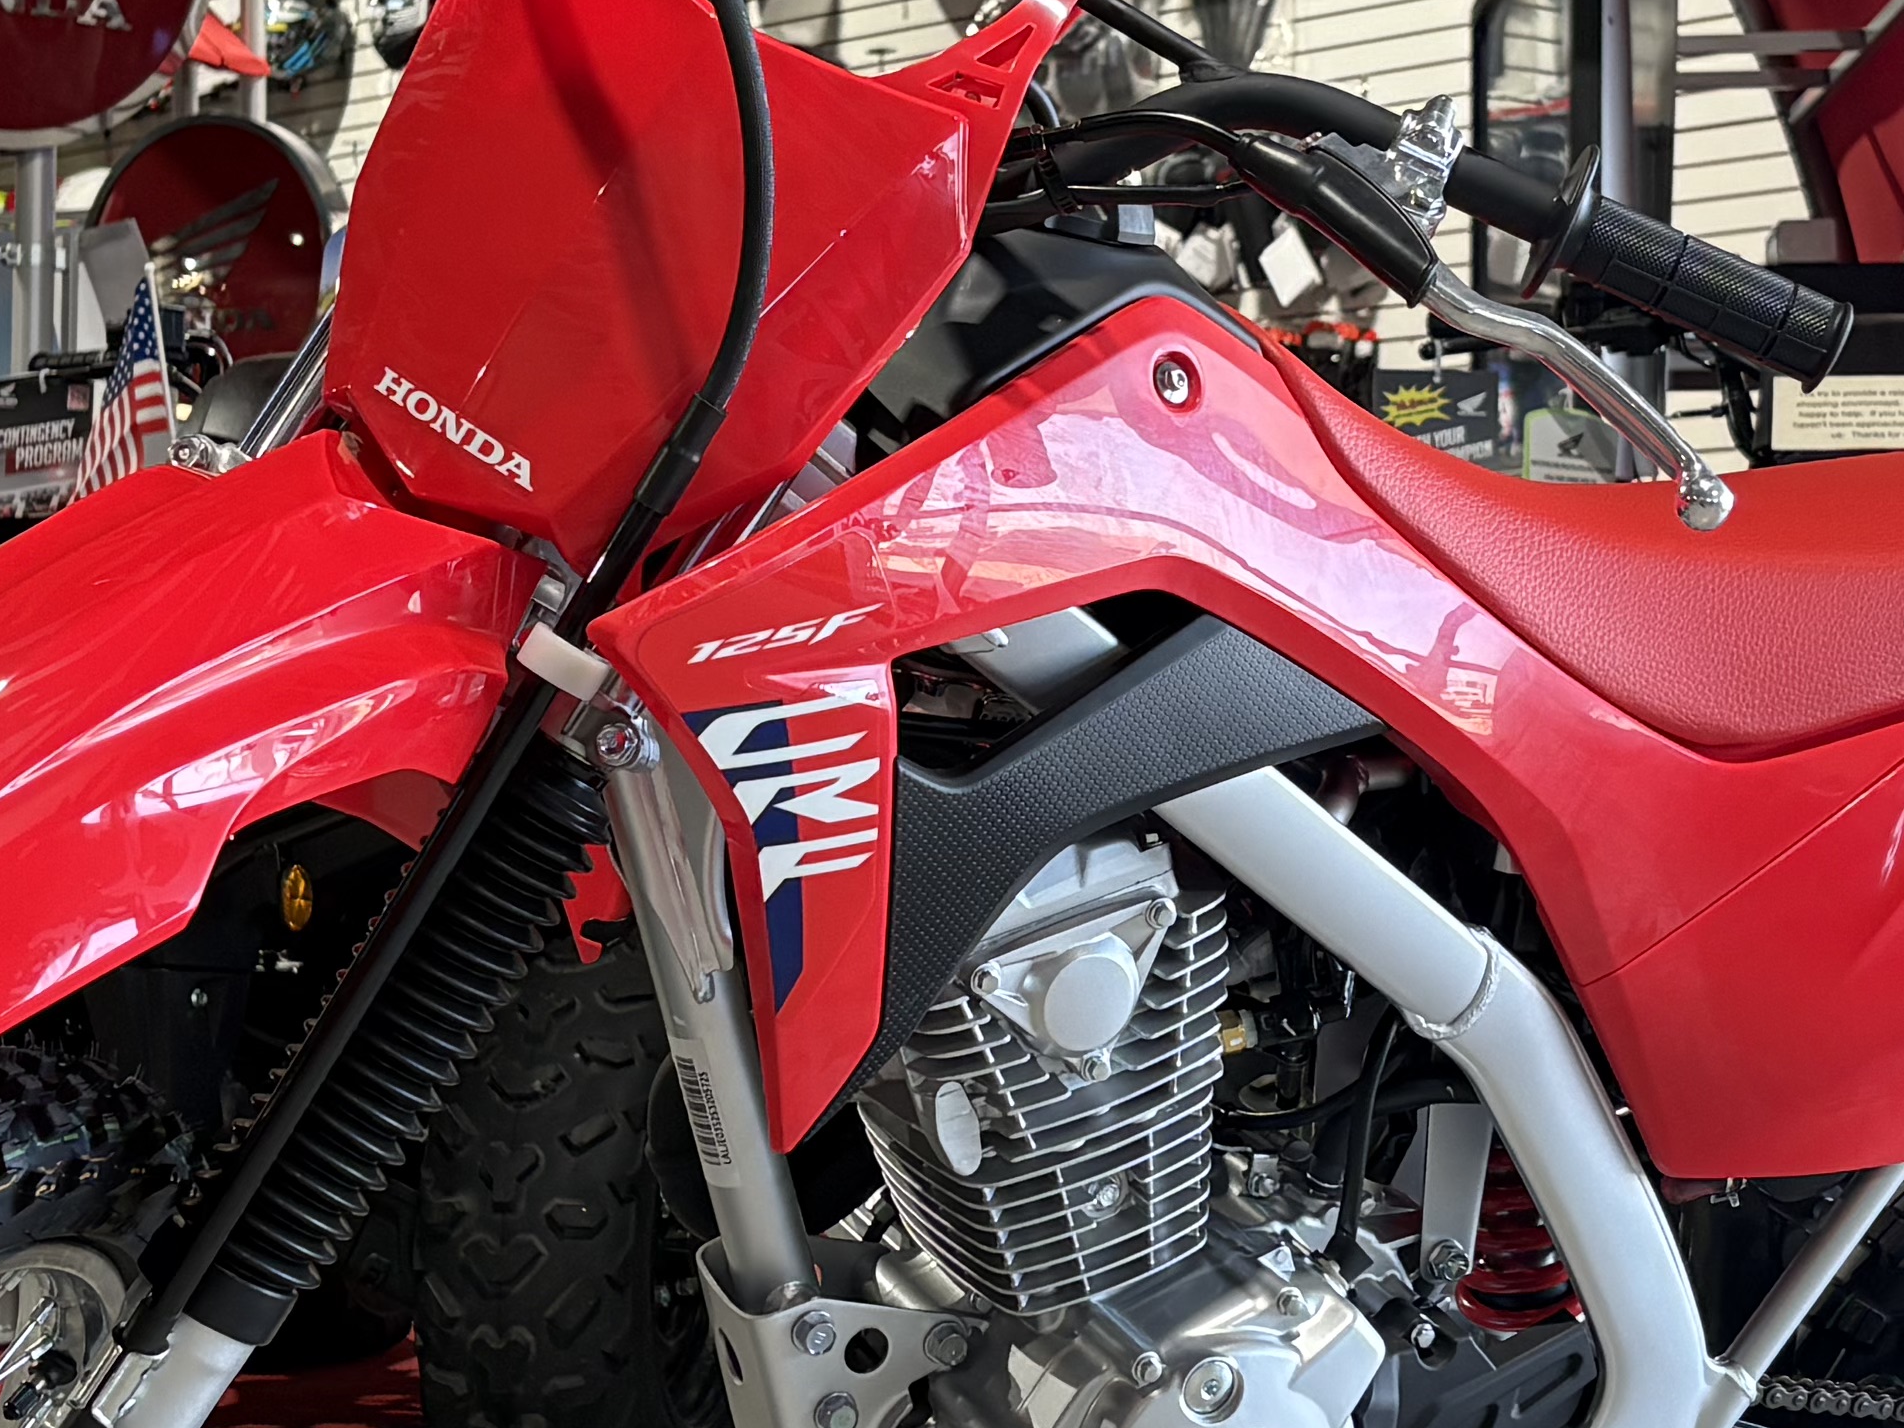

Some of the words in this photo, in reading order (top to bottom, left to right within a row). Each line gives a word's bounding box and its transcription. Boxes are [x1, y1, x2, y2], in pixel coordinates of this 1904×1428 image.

[15, 437, 84, 471] PROGRAM
[374, 366, 533, 492] HONDA
[687, 603, 885, 664] 125F
[698, 684, 881, 902] CRF
